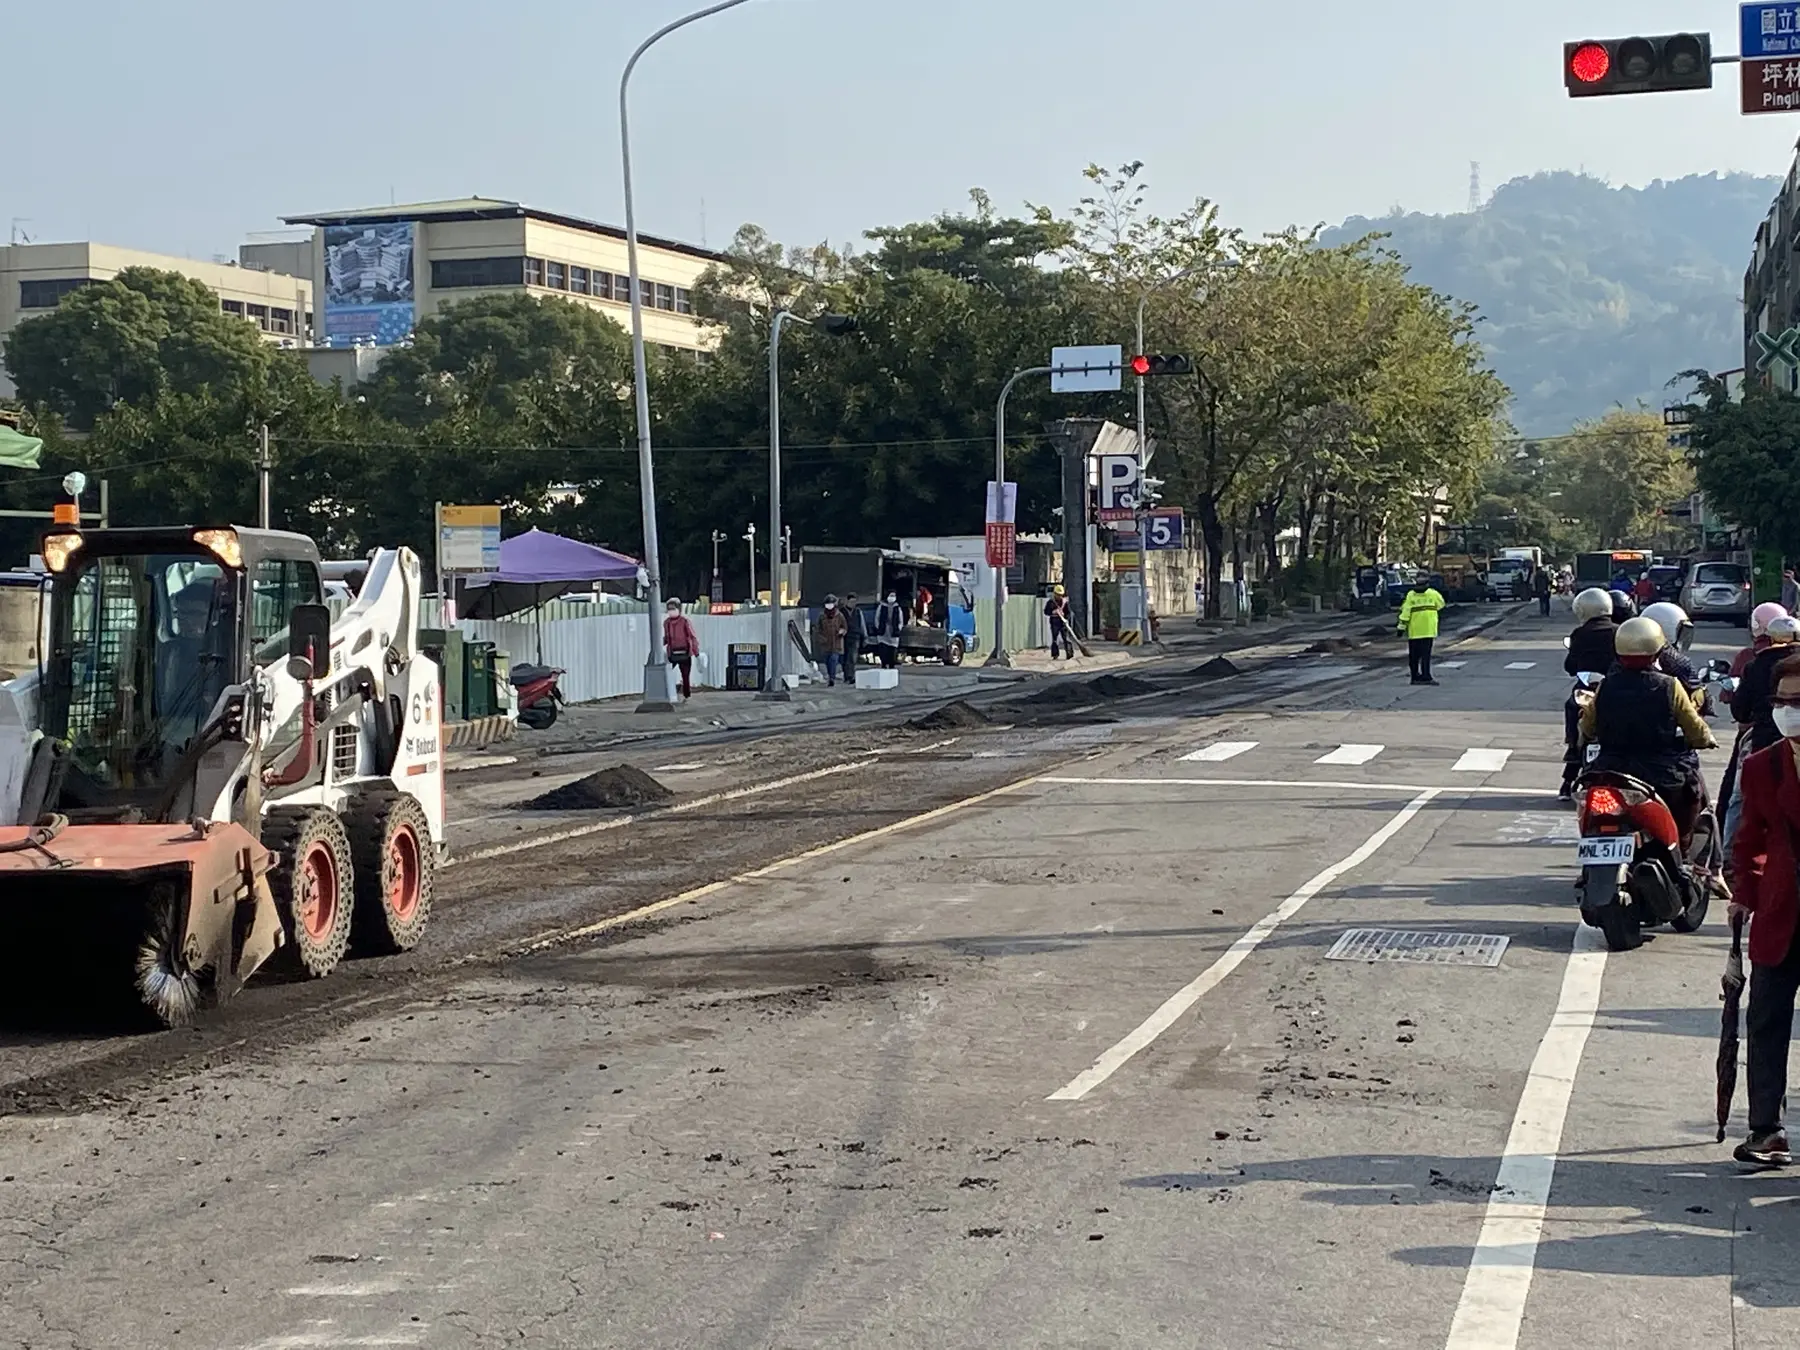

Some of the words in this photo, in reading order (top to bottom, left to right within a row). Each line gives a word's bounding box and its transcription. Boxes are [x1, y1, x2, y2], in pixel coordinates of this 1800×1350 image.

[1762, 61, 1800, 89] 坪林
[1102, 456, 1138, 509] P
[1151, 517, 1171, 545] 5
[412, 692, 421, 725] 6
